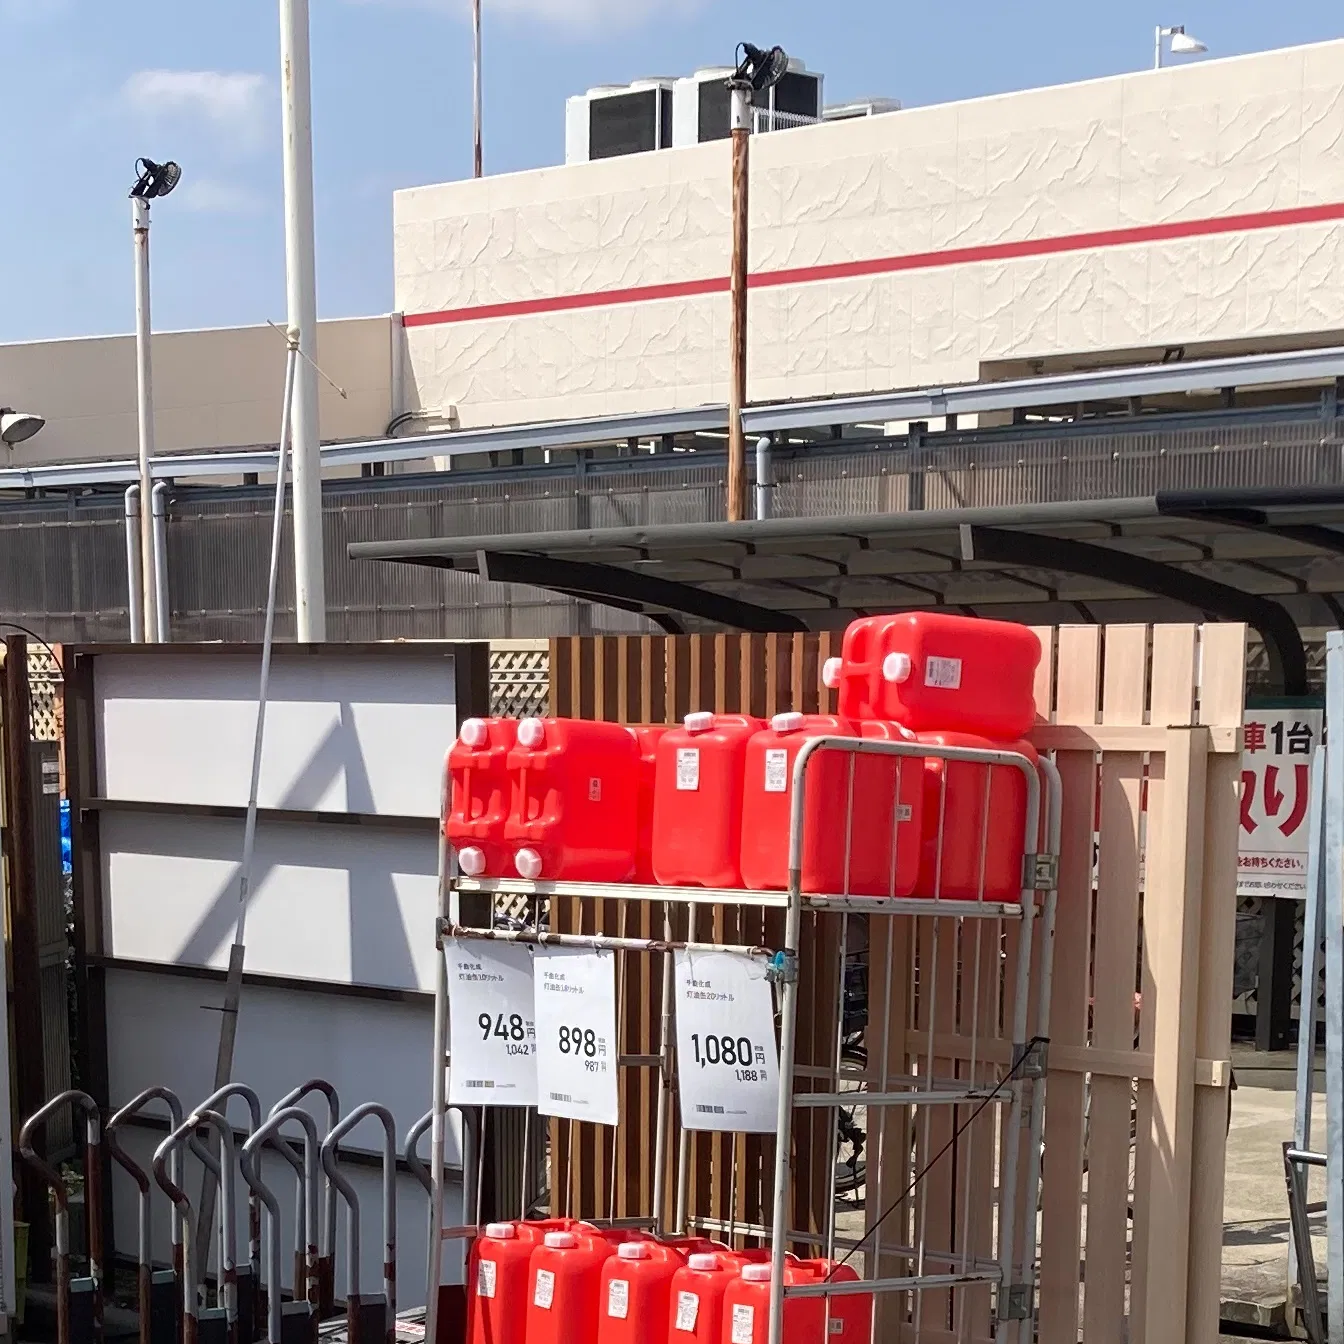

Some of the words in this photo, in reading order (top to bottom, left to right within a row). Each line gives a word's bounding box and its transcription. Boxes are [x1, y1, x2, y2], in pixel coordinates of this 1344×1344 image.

[478, 1012, 525, 1041] 948
[505, 1044, 530, 1056] 1,042
[558, 1025, 597, 1057] 898
[691, 1033, 753, 1069] 1,080
[754, 1052, 766, 1065] 円
[584, 1059, 599, 1073] 987
[735, 1068, 758, 1082] 1,188
